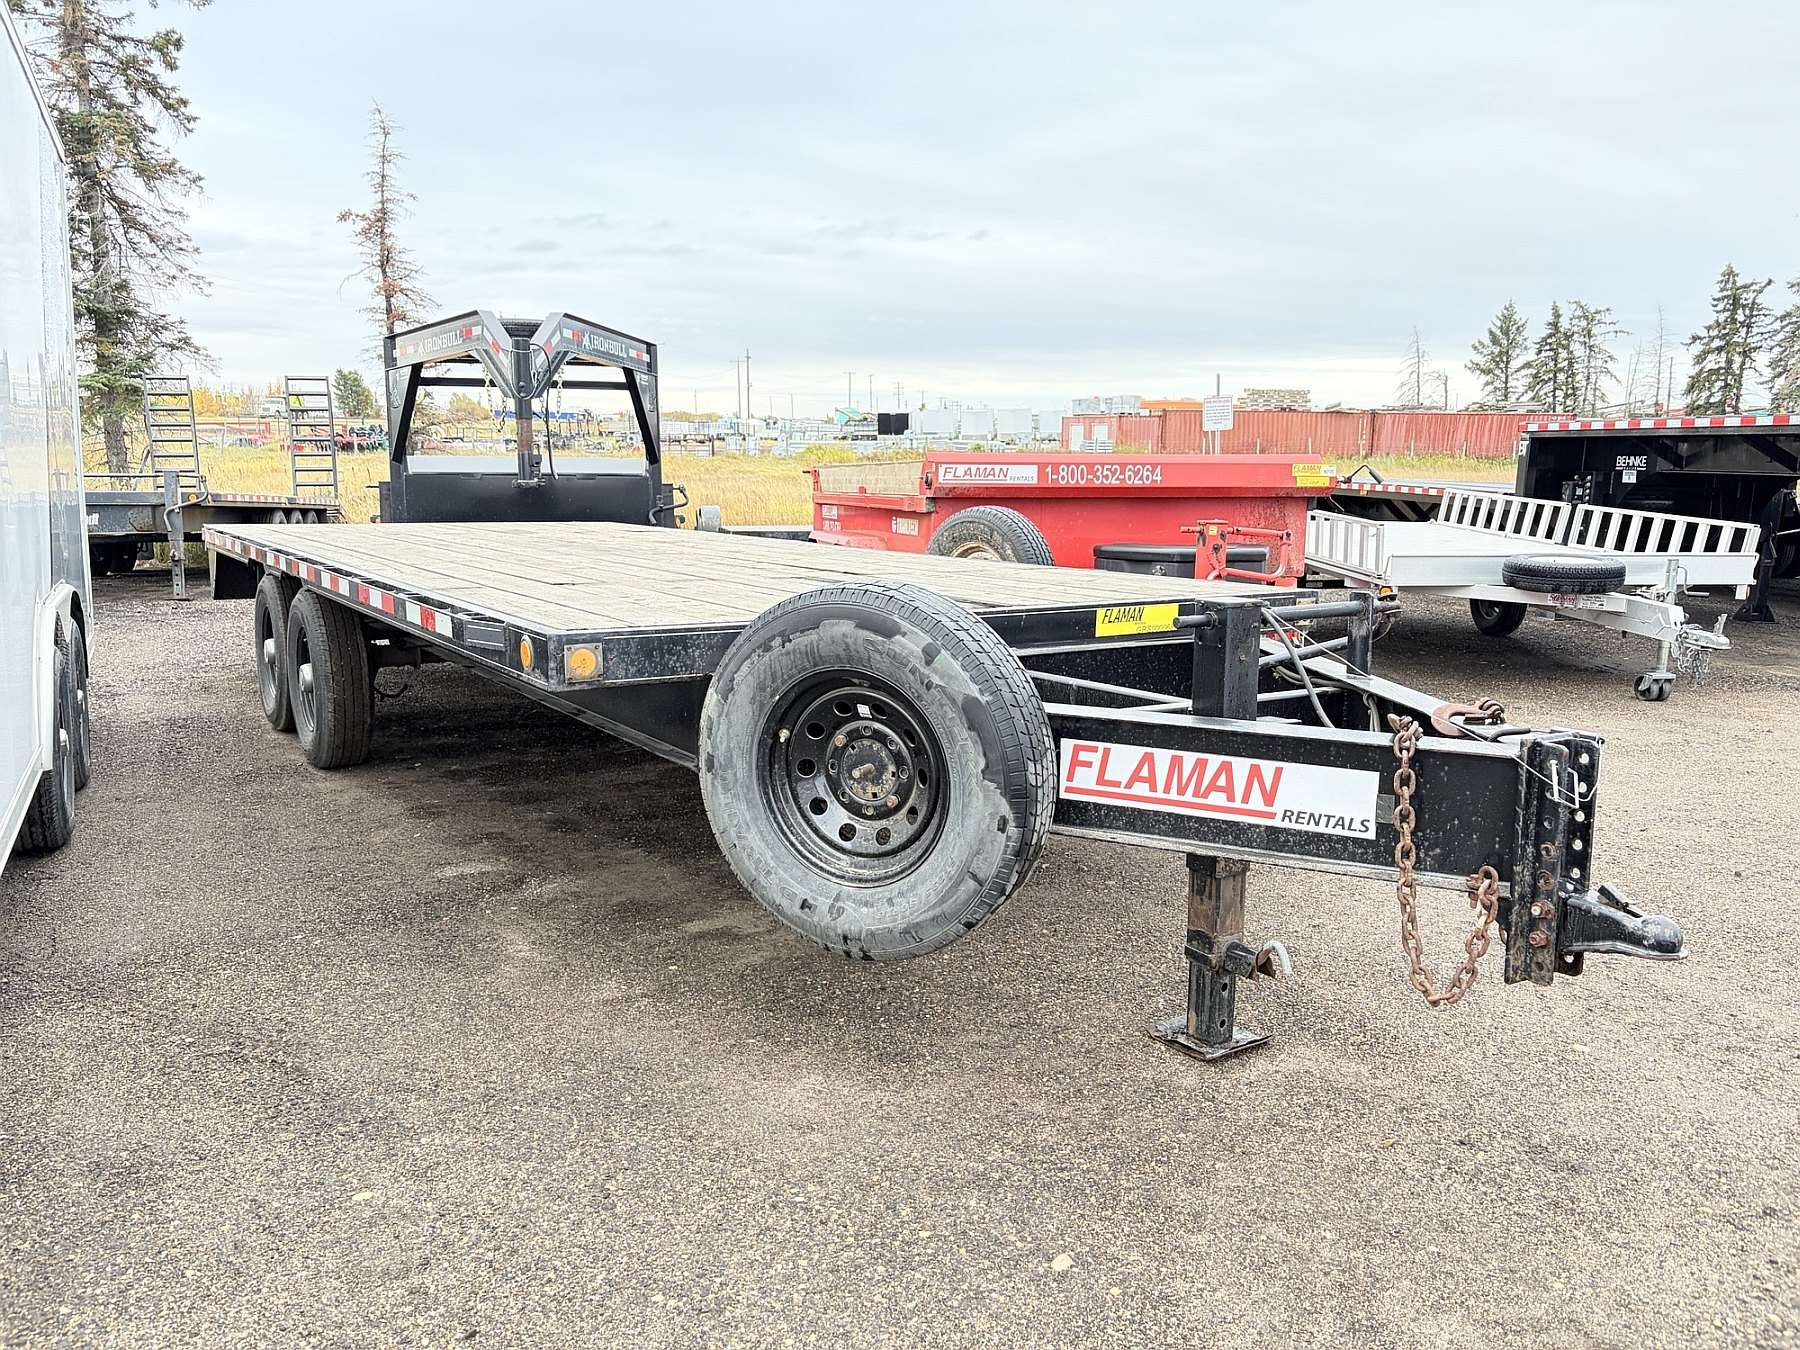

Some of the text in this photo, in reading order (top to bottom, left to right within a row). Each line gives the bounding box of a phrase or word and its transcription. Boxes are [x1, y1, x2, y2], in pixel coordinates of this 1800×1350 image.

[424, 329, 463, 353] IRONBULL
[589, 334, 627, 358] IRONBULL
[1616, 455, 1648, 467] BEHNKE
[942, 467, 1009, 478] FLAMAN
[1045, 464, 1162, 485] 1-800-352-6264
[1101, 606, 1145, 624] FLAMAN
[1066, 743, 1370, 834] FLAMAN RENTALS
